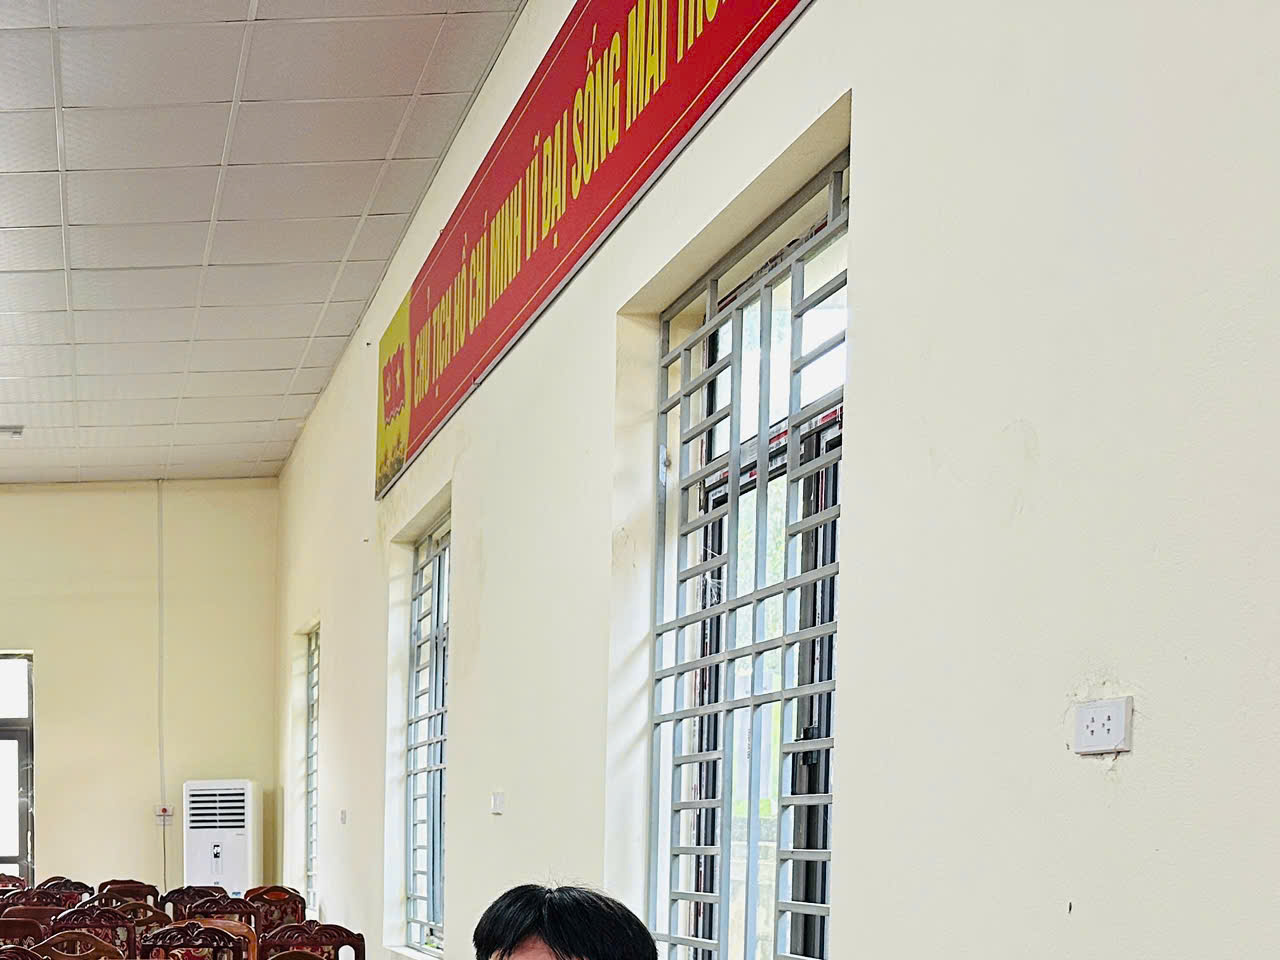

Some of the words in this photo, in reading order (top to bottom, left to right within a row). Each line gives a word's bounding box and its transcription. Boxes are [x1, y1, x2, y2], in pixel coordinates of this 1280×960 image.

[414, 285, 431, 408] CHỦ
[432, 283, 452, 398] TỊCH
[453, 231, 467, 357] HỒ
[469, 209, 488, 336] CHÍ
[489, 177, 522, 310] MINH
[542, 108, 568, 249] ĐẠI
[571, 22, 621, 200] SỐNG
